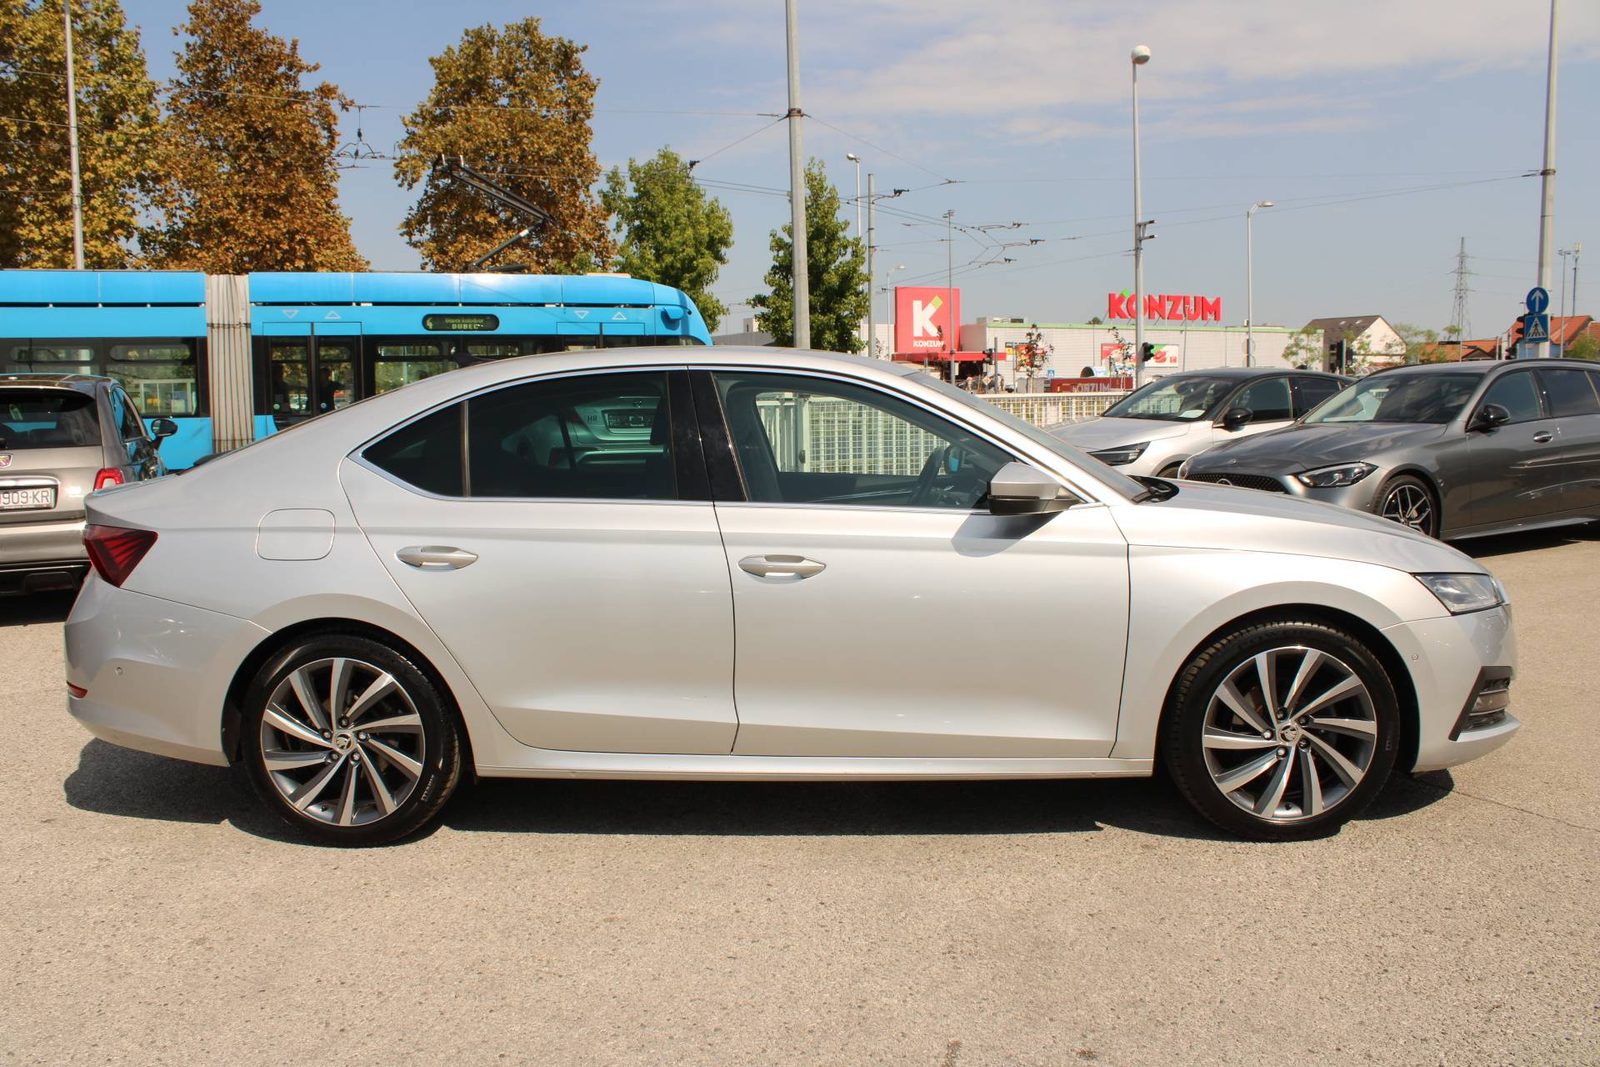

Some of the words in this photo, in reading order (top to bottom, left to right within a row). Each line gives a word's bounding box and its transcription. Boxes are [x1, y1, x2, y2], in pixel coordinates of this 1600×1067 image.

[912, 296, 943, 337] K
[1108, 288, 1222, 321] KONZUM
[912, 340, 944, 348] KONZUM
